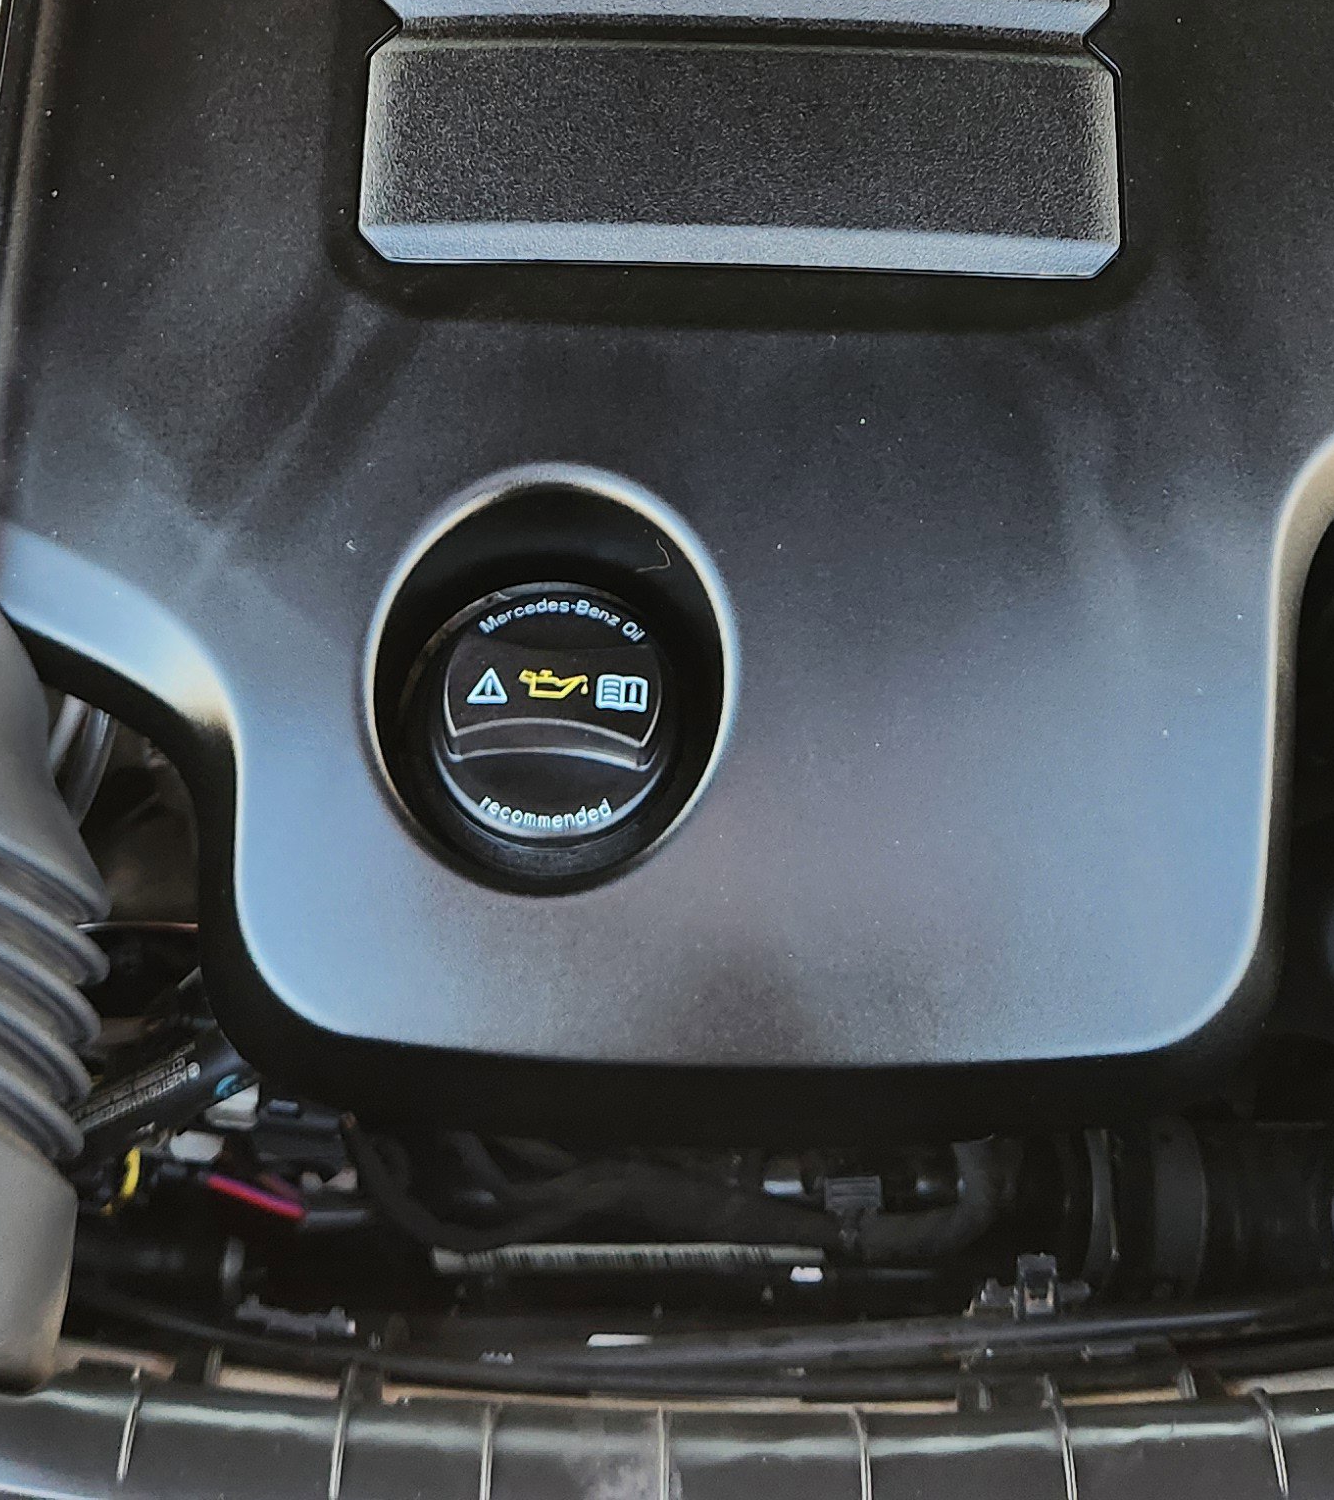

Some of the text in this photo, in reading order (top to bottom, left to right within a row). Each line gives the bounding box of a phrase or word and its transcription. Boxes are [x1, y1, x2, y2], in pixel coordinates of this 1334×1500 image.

[478, 598, 646, 643] Mercedes-Benz Oil
[478, 795, 612, 828] recommended
